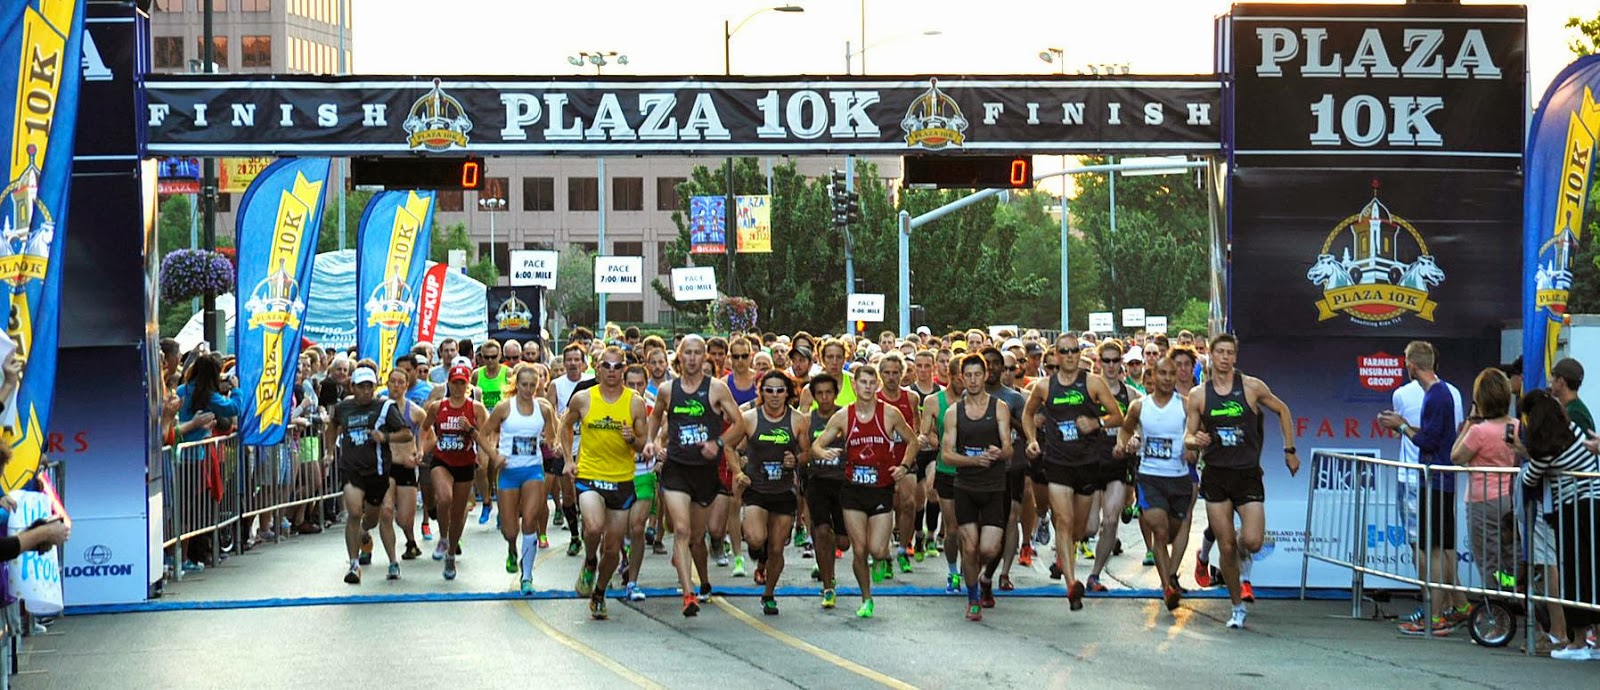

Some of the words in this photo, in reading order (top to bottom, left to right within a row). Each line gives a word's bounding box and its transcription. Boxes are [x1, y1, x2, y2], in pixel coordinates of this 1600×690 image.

[1255, 27, 1502, 79] PLAZA
[25, 43, 60, 138] 10K
[148, 103, 388, 127] FINISH
[500, 92, 731, 141] PLAZA
[756, 90, 881, 139] 10K
[982, 102, 1211, 126] FINISH
[1310, 93, 1444, 147] 10K
[417, 131, 442, 140] PLAZA
[915, 130, 938, 139] PLAZA
[462, 162, 478, 188] 0
[1010, 158, 1026, 187] 0
[1565, 141, 1590, 209] 10K
[278, 210, 303, 256] 10K
[393, 223, 415, 262] 10K
[523, 260, 545, 268] PACE
[608, 264, 630, 272] PACE
[515, 271, 552, 280] 6:00/MILE
[600, 274, 637, 283] 7:00/MILE
[684, 274, 703, 282] PACE
[1332, 289, 1383, 305] PLAZA
[1388, 290, 1419, 306] 10K
[1363, 358, 1399, 367] FARMERS
[1360, 368, 1403, 377] INSURANCE
[1367, 377, 1395, 386] GROUP
[64, 564, 132, 578] LOCKTON
